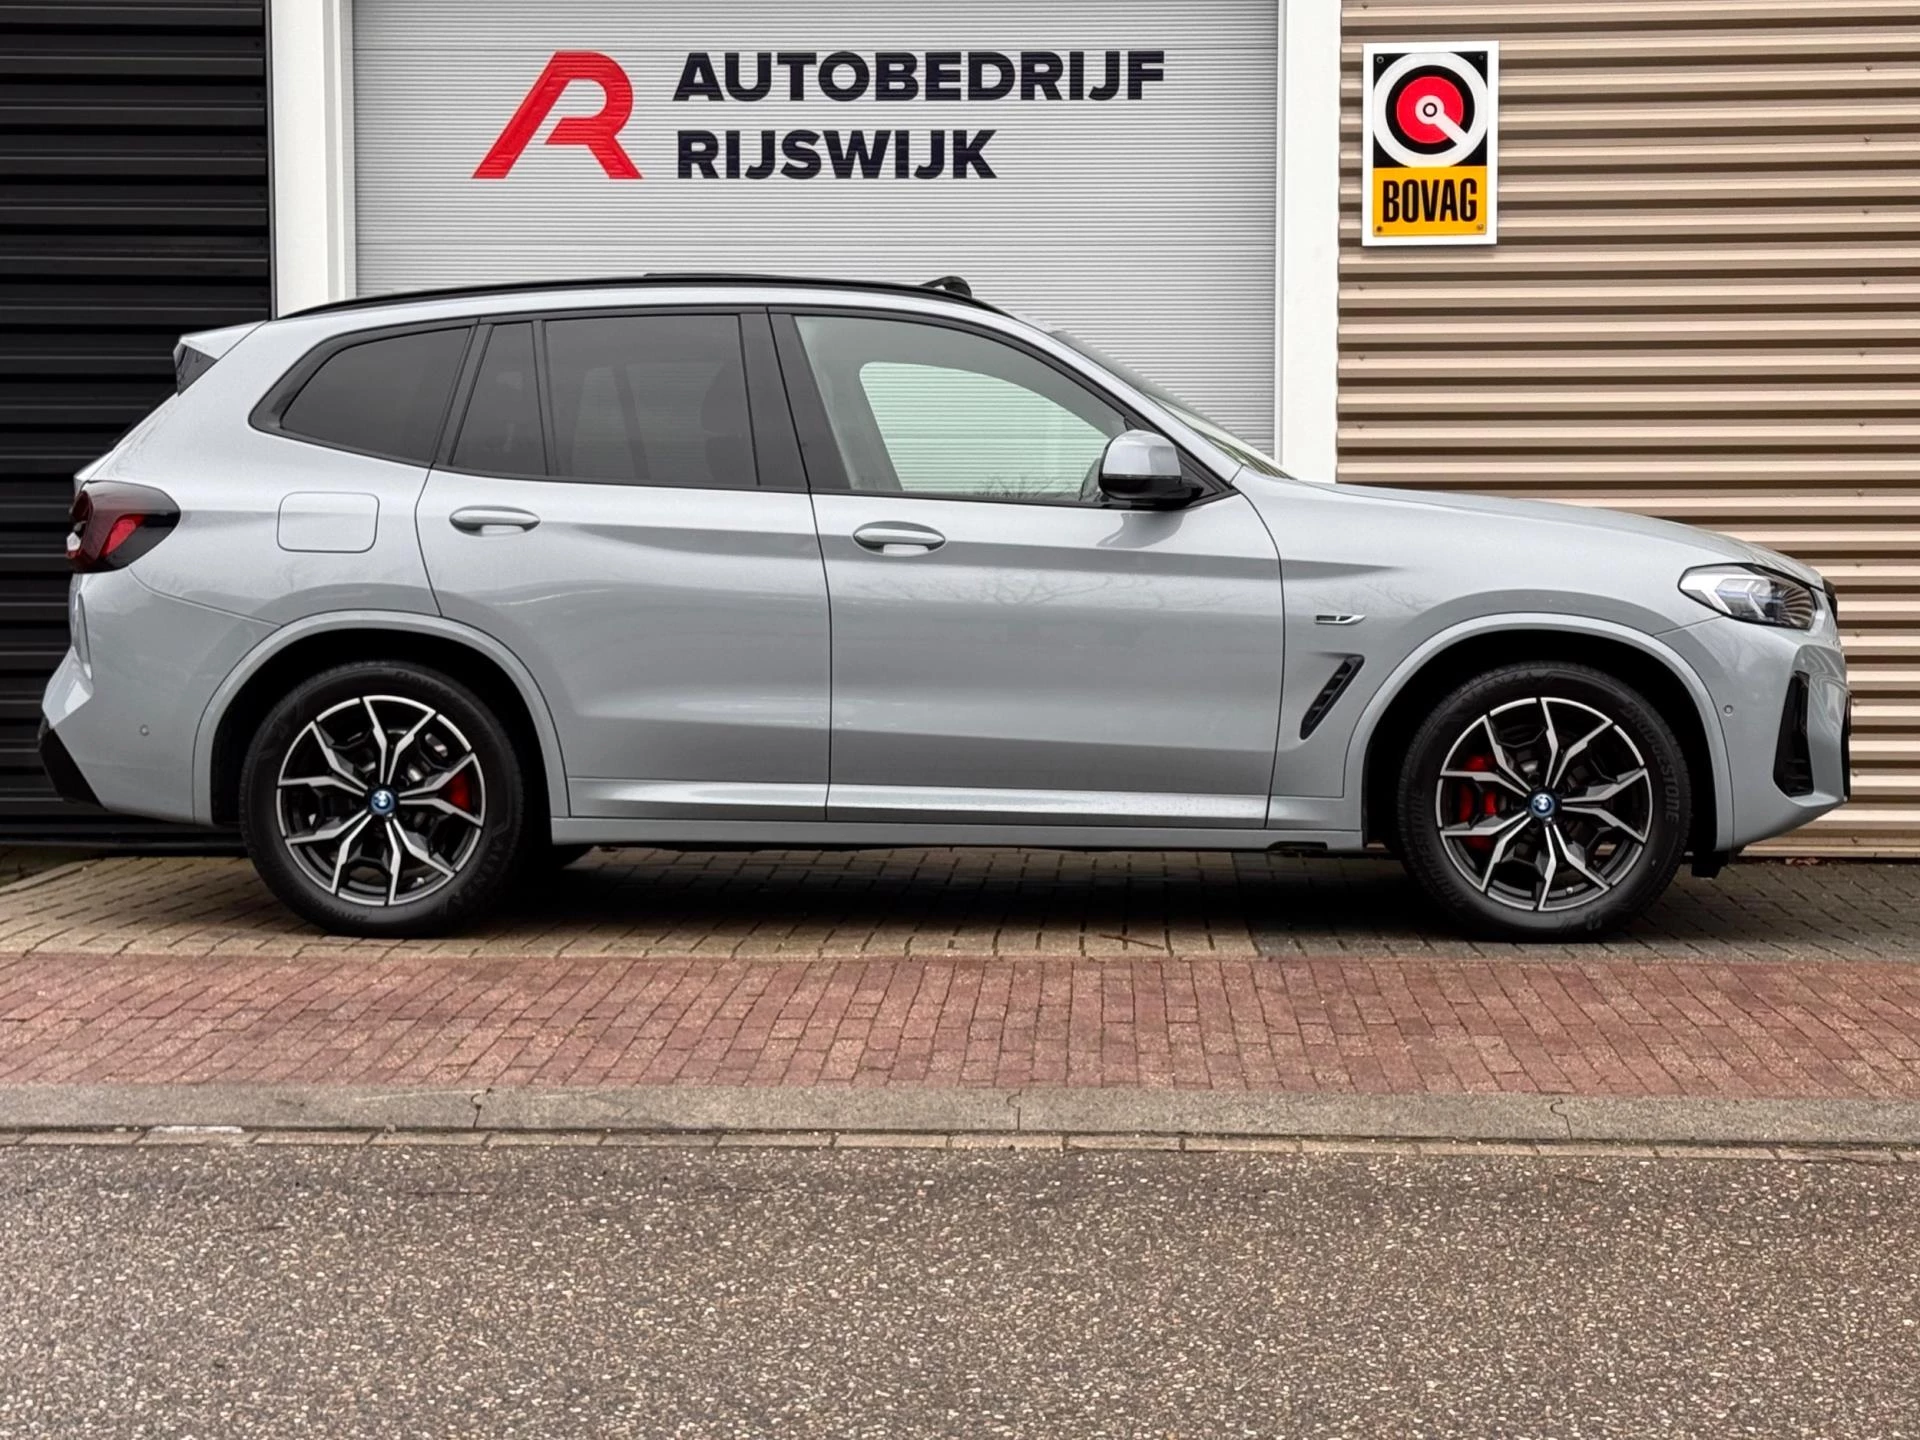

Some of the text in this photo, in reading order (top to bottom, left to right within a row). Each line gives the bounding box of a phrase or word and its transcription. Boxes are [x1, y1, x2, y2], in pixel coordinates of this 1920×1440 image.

[673, 51, 1165, 102] AUTOBEDRIJF
[677, 129, 998, 180] RIJSWIJK
[1382, 178, 1478, 223] BOVAG
